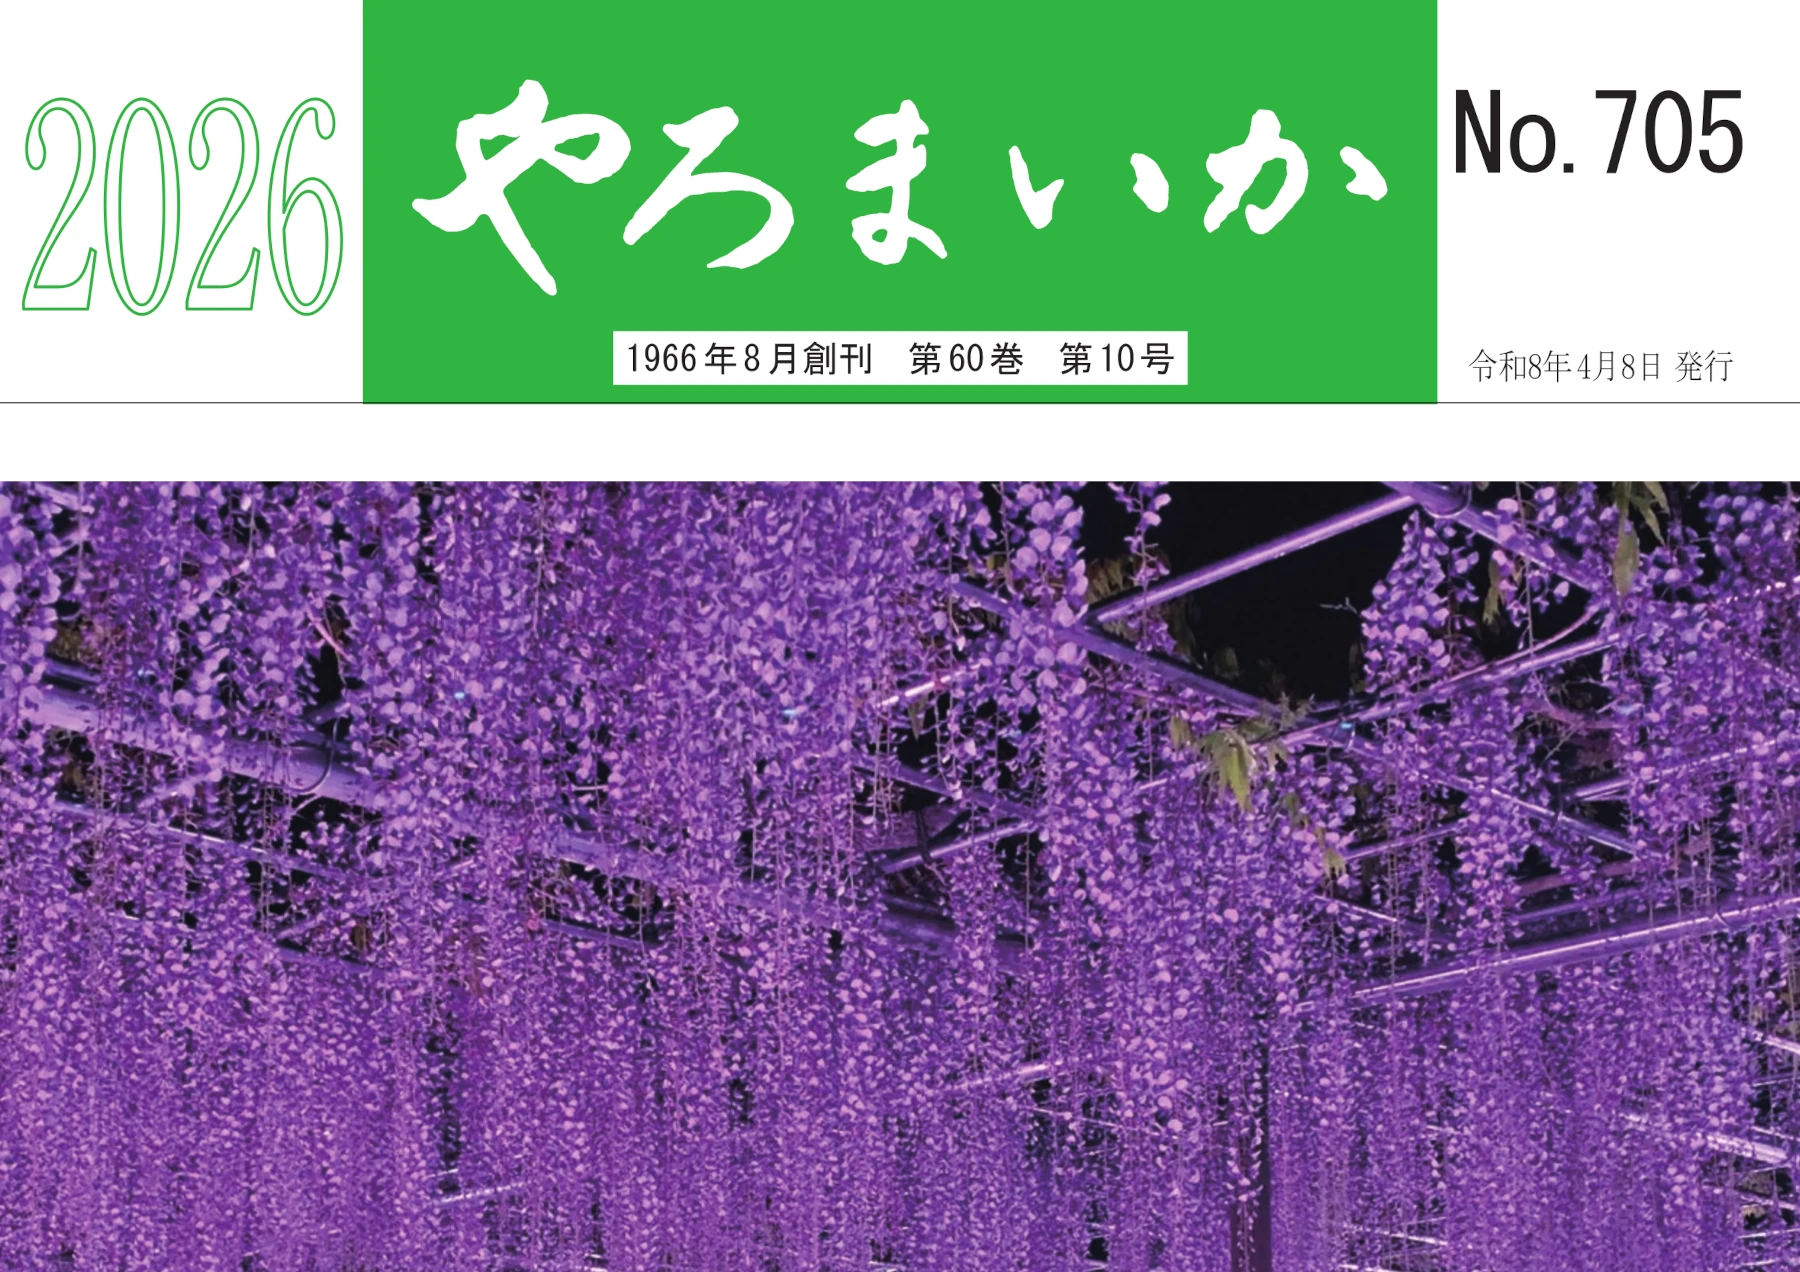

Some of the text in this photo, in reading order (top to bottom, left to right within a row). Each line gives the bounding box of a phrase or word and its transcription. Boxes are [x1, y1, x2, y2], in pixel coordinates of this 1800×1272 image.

[22, 97, 343, 316] 2026
[412, 80, 1387, 295] やろまいか
[627, 342, 1175, 375] 1966年8月創刊 第60巻 第10号
